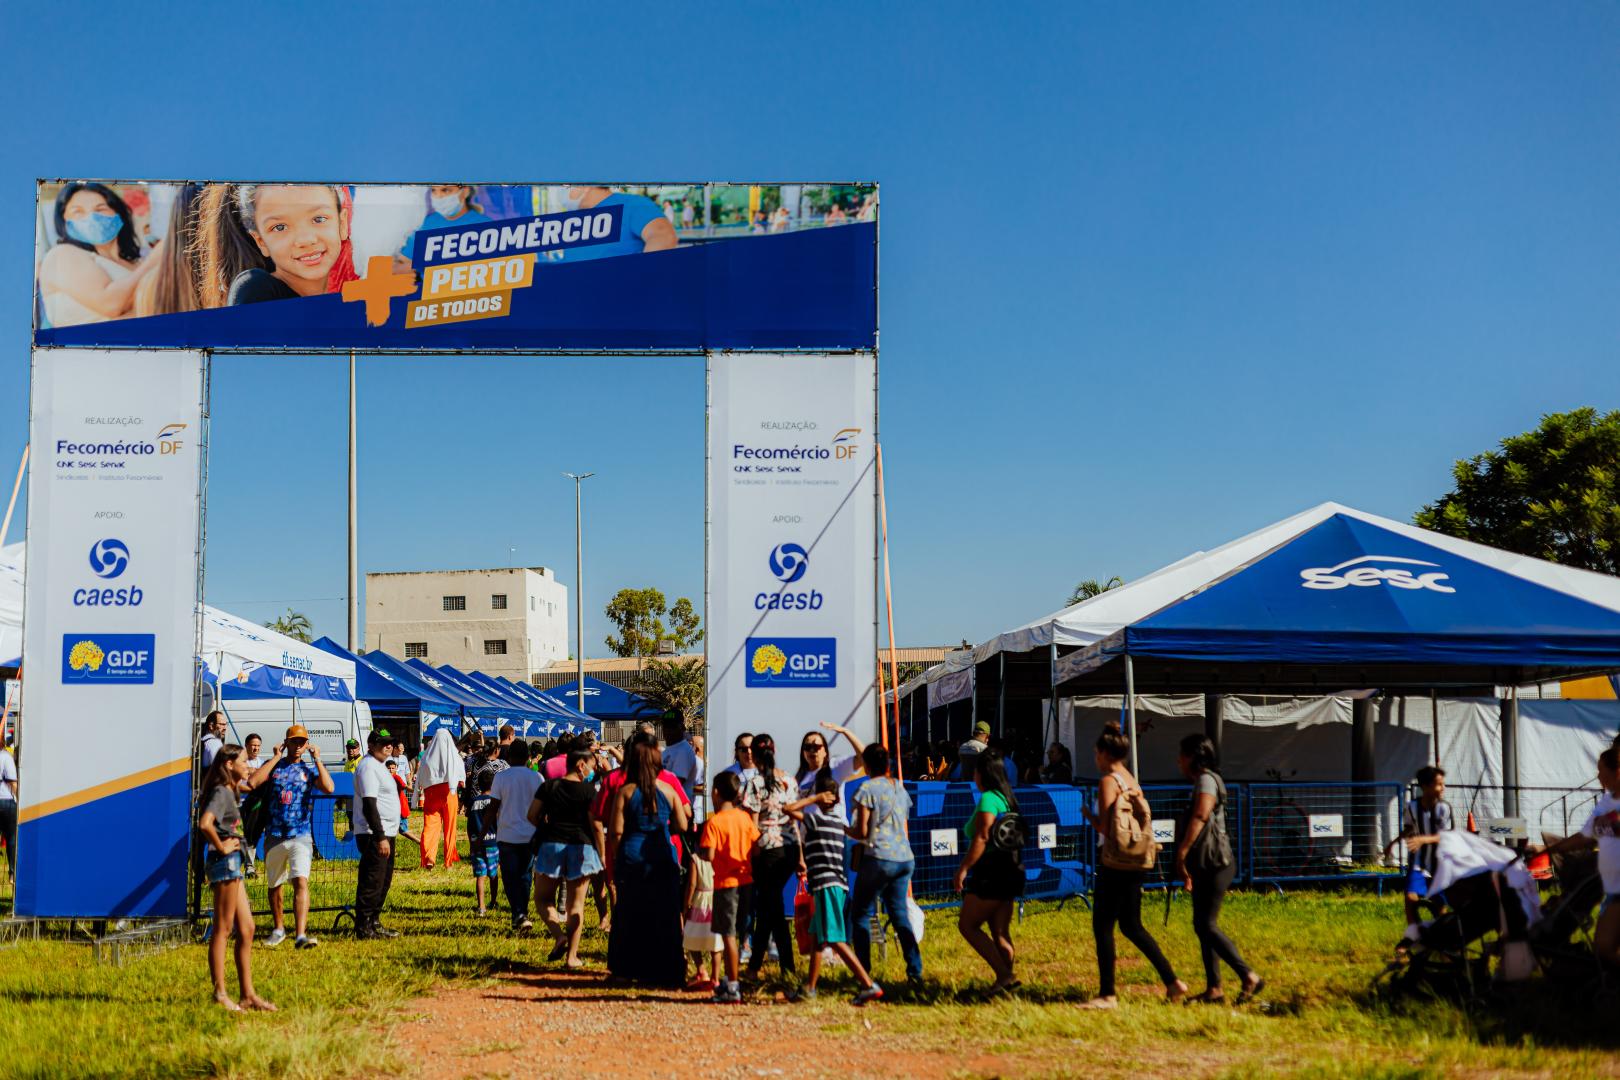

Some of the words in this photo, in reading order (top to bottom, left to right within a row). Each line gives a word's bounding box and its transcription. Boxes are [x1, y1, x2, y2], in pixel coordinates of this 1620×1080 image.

[424, 212, 613, 262] FECOMÉRCIO
[430, 258, 525, 294] PERTO
[414, 304, 438, 322] DE
[441, 295, 503, 318] TODOS
[56, 440, 155, 455] Fecomércio
[160, 440, 184, 455] DF
[733, 444, 830, 459] Fecomércio
[835, 445, 859, 459] DF
[73, 585, 143, 607] caesb
[754, 589, 823, 610] caesb
[107, 650, 149, 667] GDF
[789, 654, 830, 671] GDF
